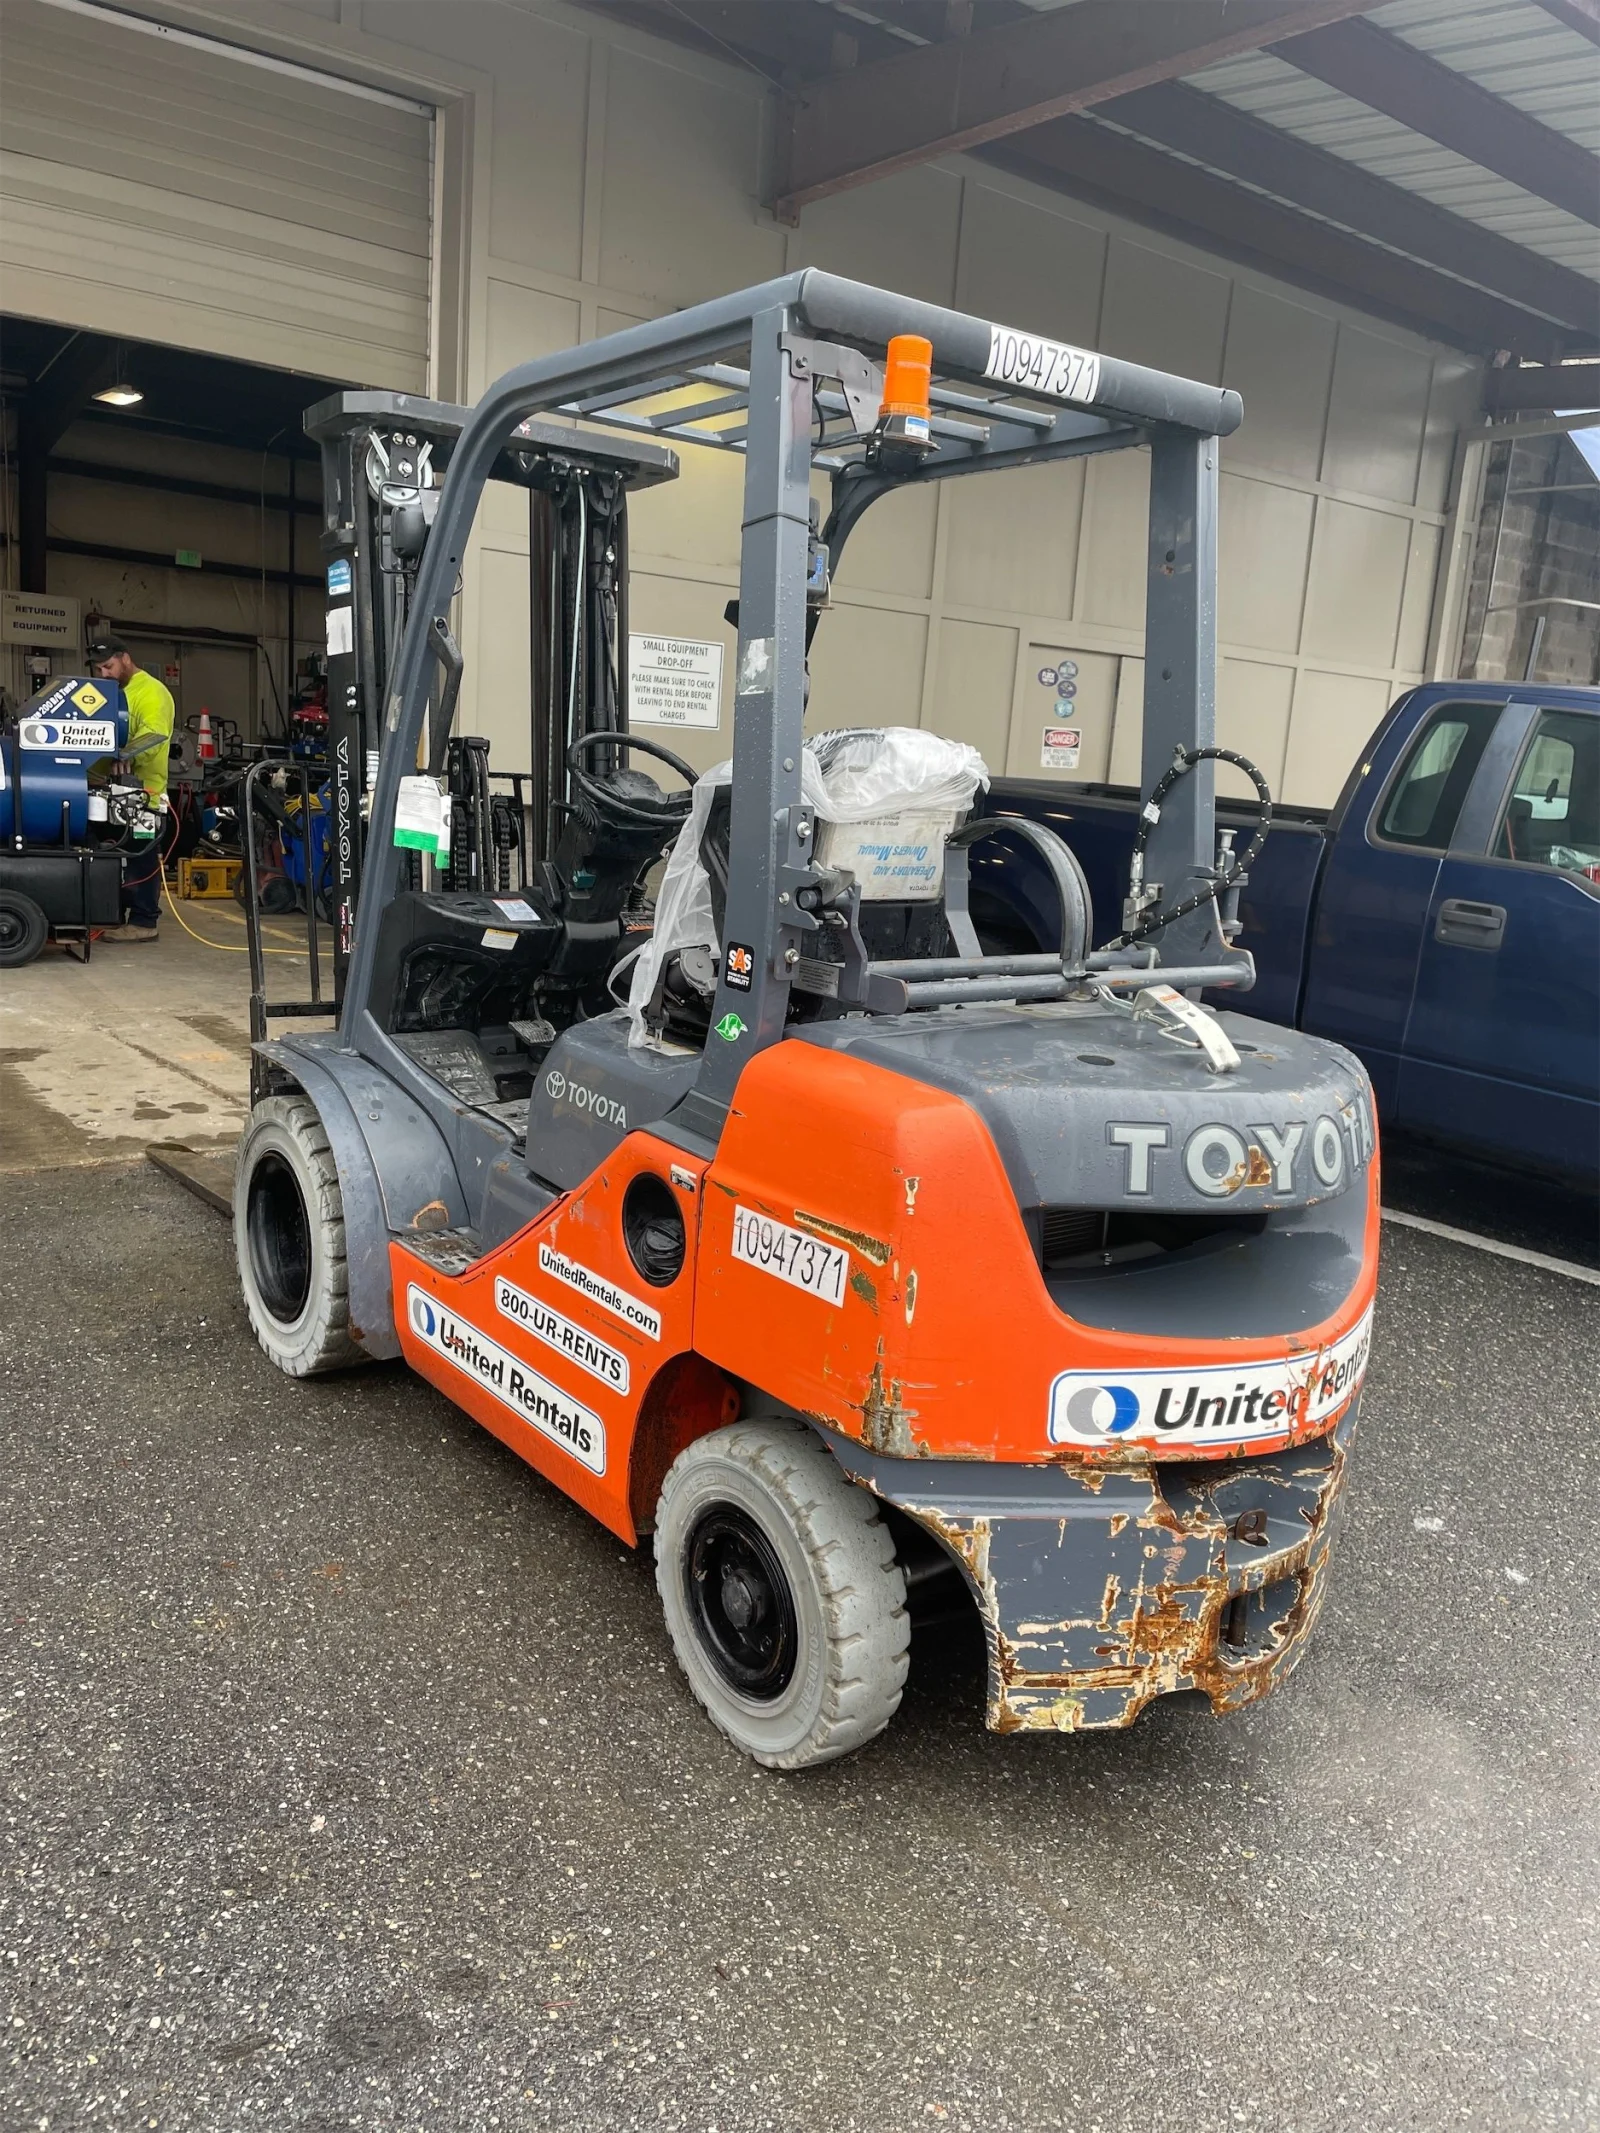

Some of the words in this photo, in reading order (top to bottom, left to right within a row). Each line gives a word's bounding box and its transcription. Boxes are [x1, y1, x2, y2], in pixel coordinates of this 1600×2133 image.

[992, 331, 1095, 401] 10947371
[15, 605, 66, 617] RETURNED
[13, 621, 68, 634] EQUIPMENT
[643, 640, 666, 653] SMALL
[667, 643, 709, 657] EQUIPMENT
[657, 656, 693, 669] DROP-OFF
[632, 673, 652, 683] PLEASE
[653, 675, 670, 685] MAKE
[671, 677, 686, 687] SURE
[687, 679, 695, 687] TO
[696, 680, 715, 689] CHECK
[38, 700, 54, 715] 200
[58, 678, 79, 697] Turbo
[634, 685, 651, 694] WITH
[652, 687, 673, 697] RENTAL
[675, 689, 689, 698] DESK
[690, 690, 712, 700] BEFORE
[637, 697, 663, 707] LEAVING
[664, 699, 672, 708] TO
[673, 700, 685, 709] END
[687, 701, 708, 711] RENTAL
[659, 711, 686, 720] CHARGES
[62, 725, 106, 736] United
[1049, 733, 1075, 744] DANGER
[62, 735, 111, 746] Rentals
[336, 736, 351, 884] TOYOTA
[856, 845, 892, 861] MANUAL
[872, 865, 891, 876] AND
[728, 947, 752, 973] SAS
[568, 1081, 627, 1128] TOYOTA
[1110, 1096, 1371, 1195] TOYOTA
[736, 1211, 843, 1298] 10947371
[541, 1250, 658, 1334] UnitedRentals.com
[501, 1288, 622, 1382] 800-UR-RENTS
[440, 1317, 504, 1388] United
[510, 1367, 592, 1453] Rentals
[684, 1470, 756, 1502] MAGNUM
[799, 1622, 820, 1711] SOLIDEAL
